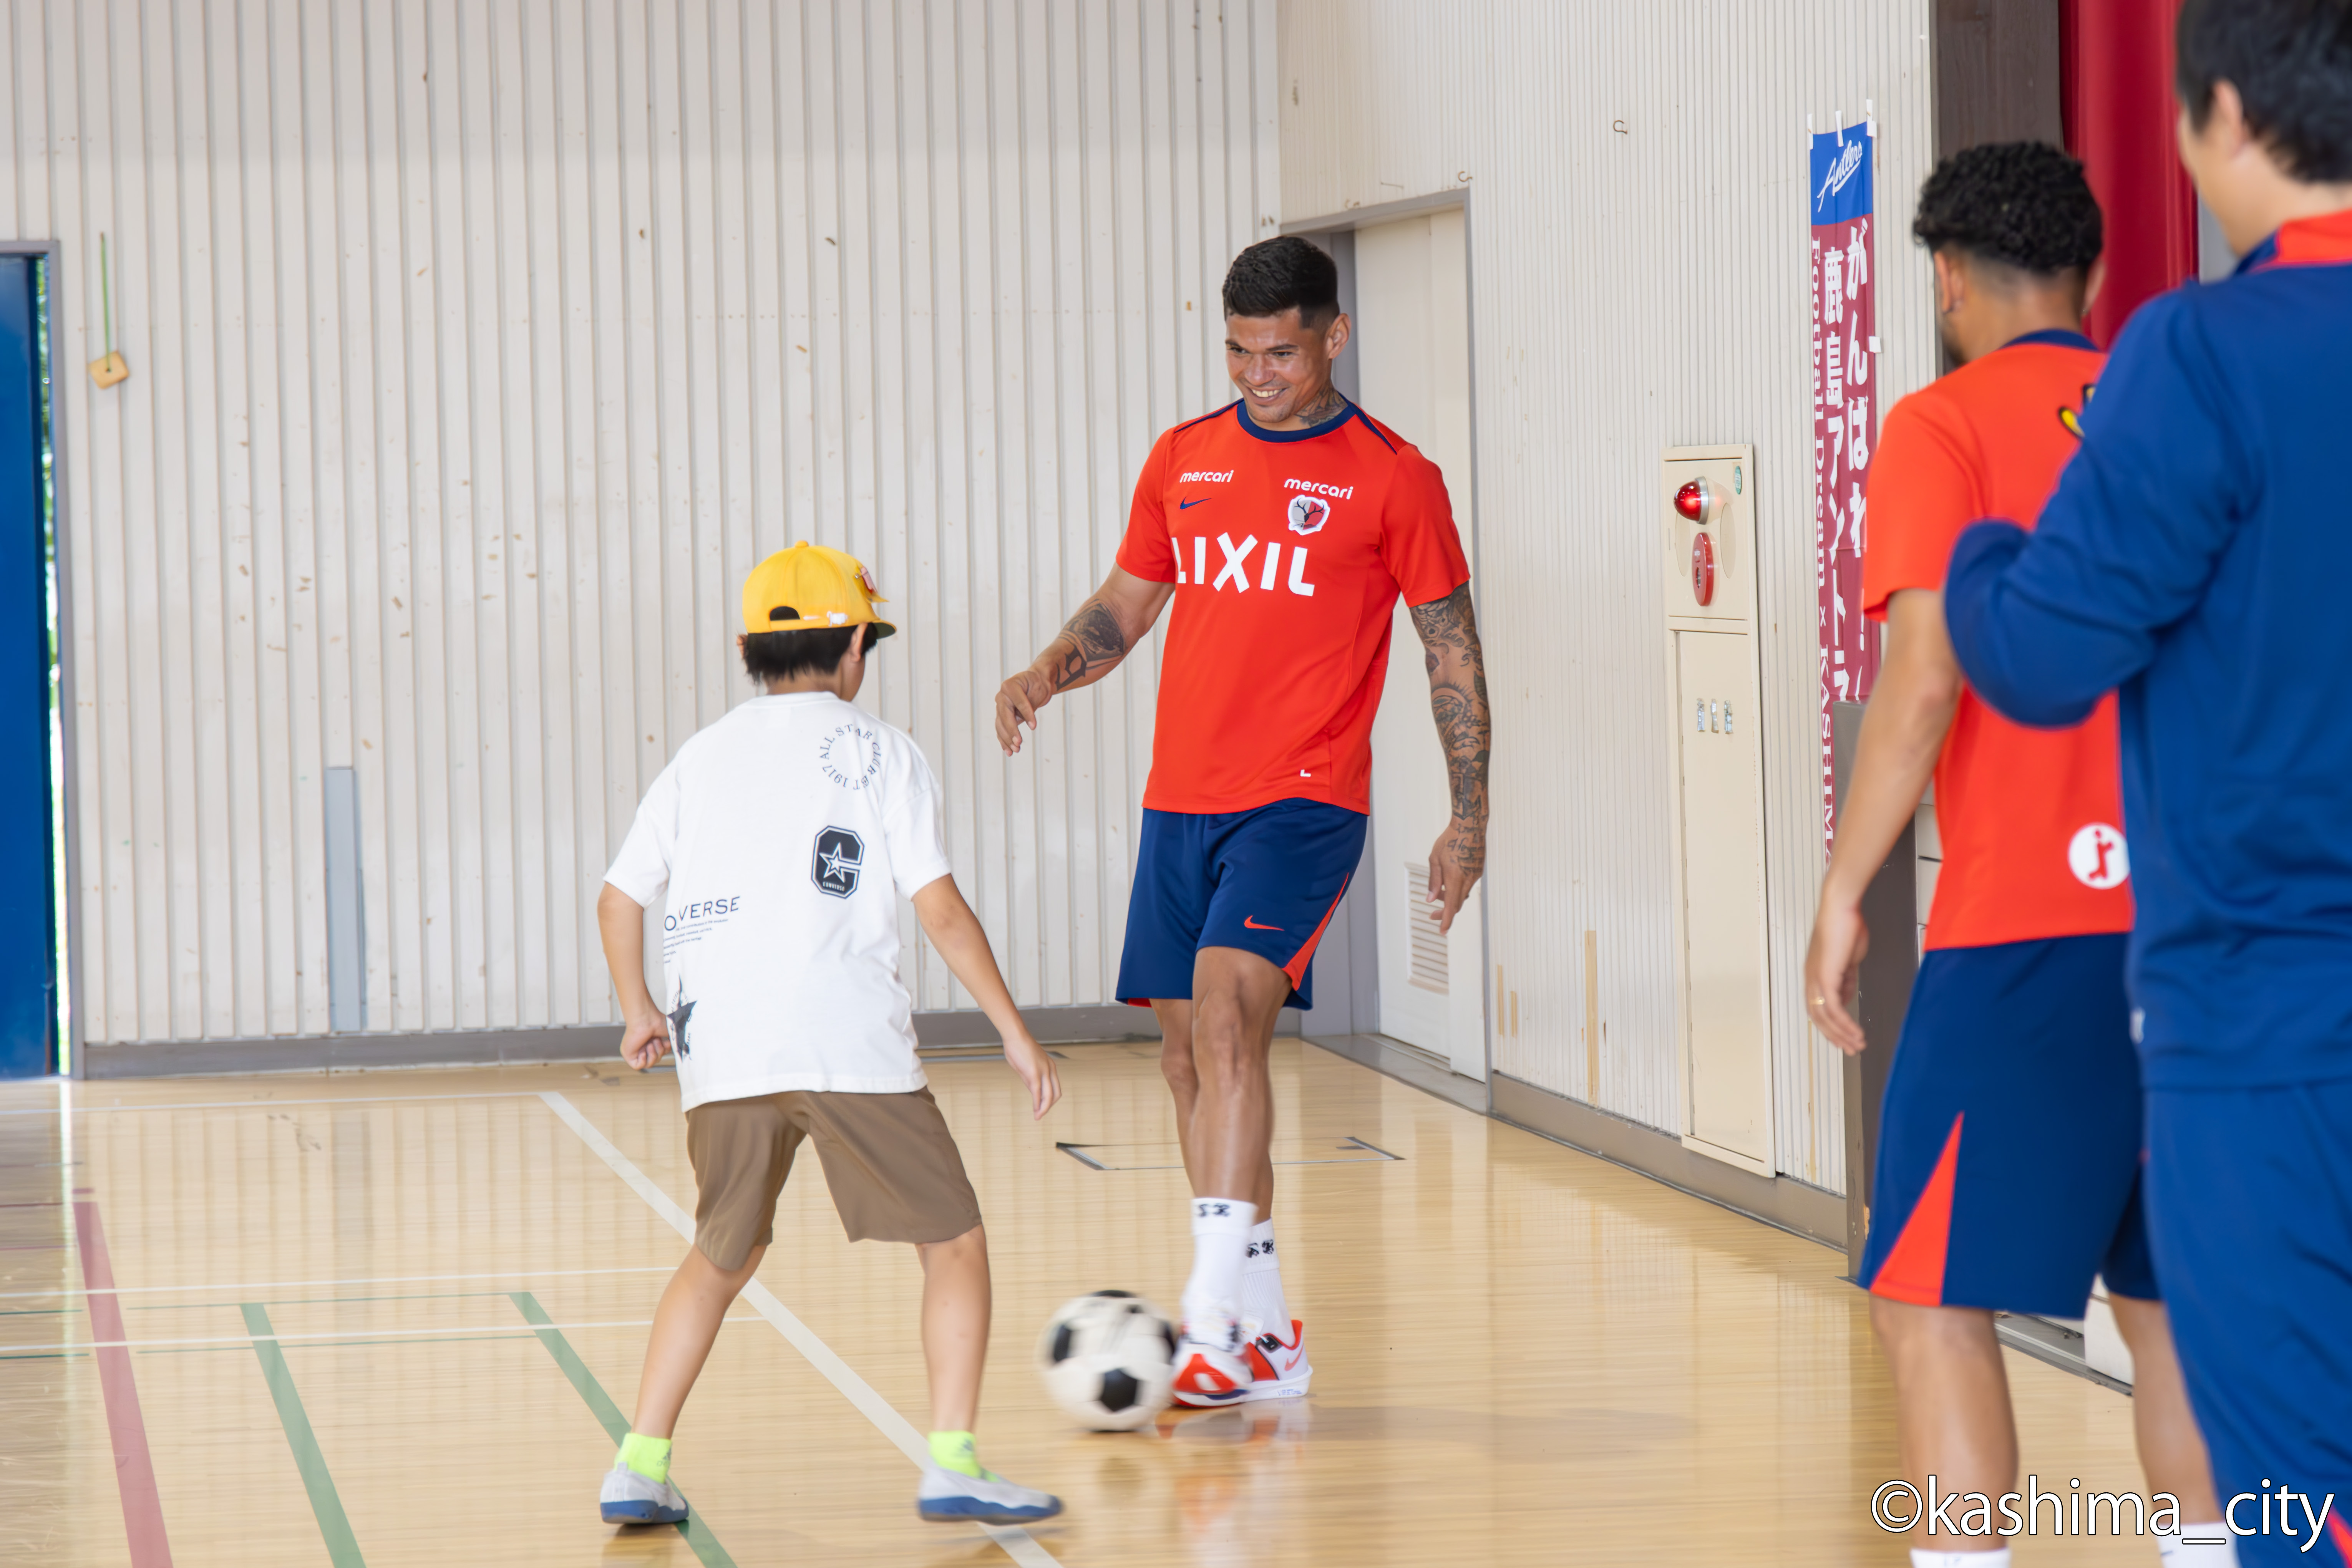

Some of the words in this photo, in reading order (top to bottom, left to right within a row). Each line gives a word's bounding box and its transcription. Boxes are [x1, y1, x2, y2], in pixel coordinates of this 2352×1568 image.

[1817, 139, 1863, 212] Antlers
[1812, 236, 1824, 422] Football
[1179, 470, 1234, 483] mercari
[1284, 478, 1353, 500] mercari
[1815, 435, 1825, 589] Dream
[1171, 532, 1315, 597] LIXIL
[835, 724, 872, 740] STAR
[819, 736, 836, 760] ALL
[822, 764, 849, 788] 1917
